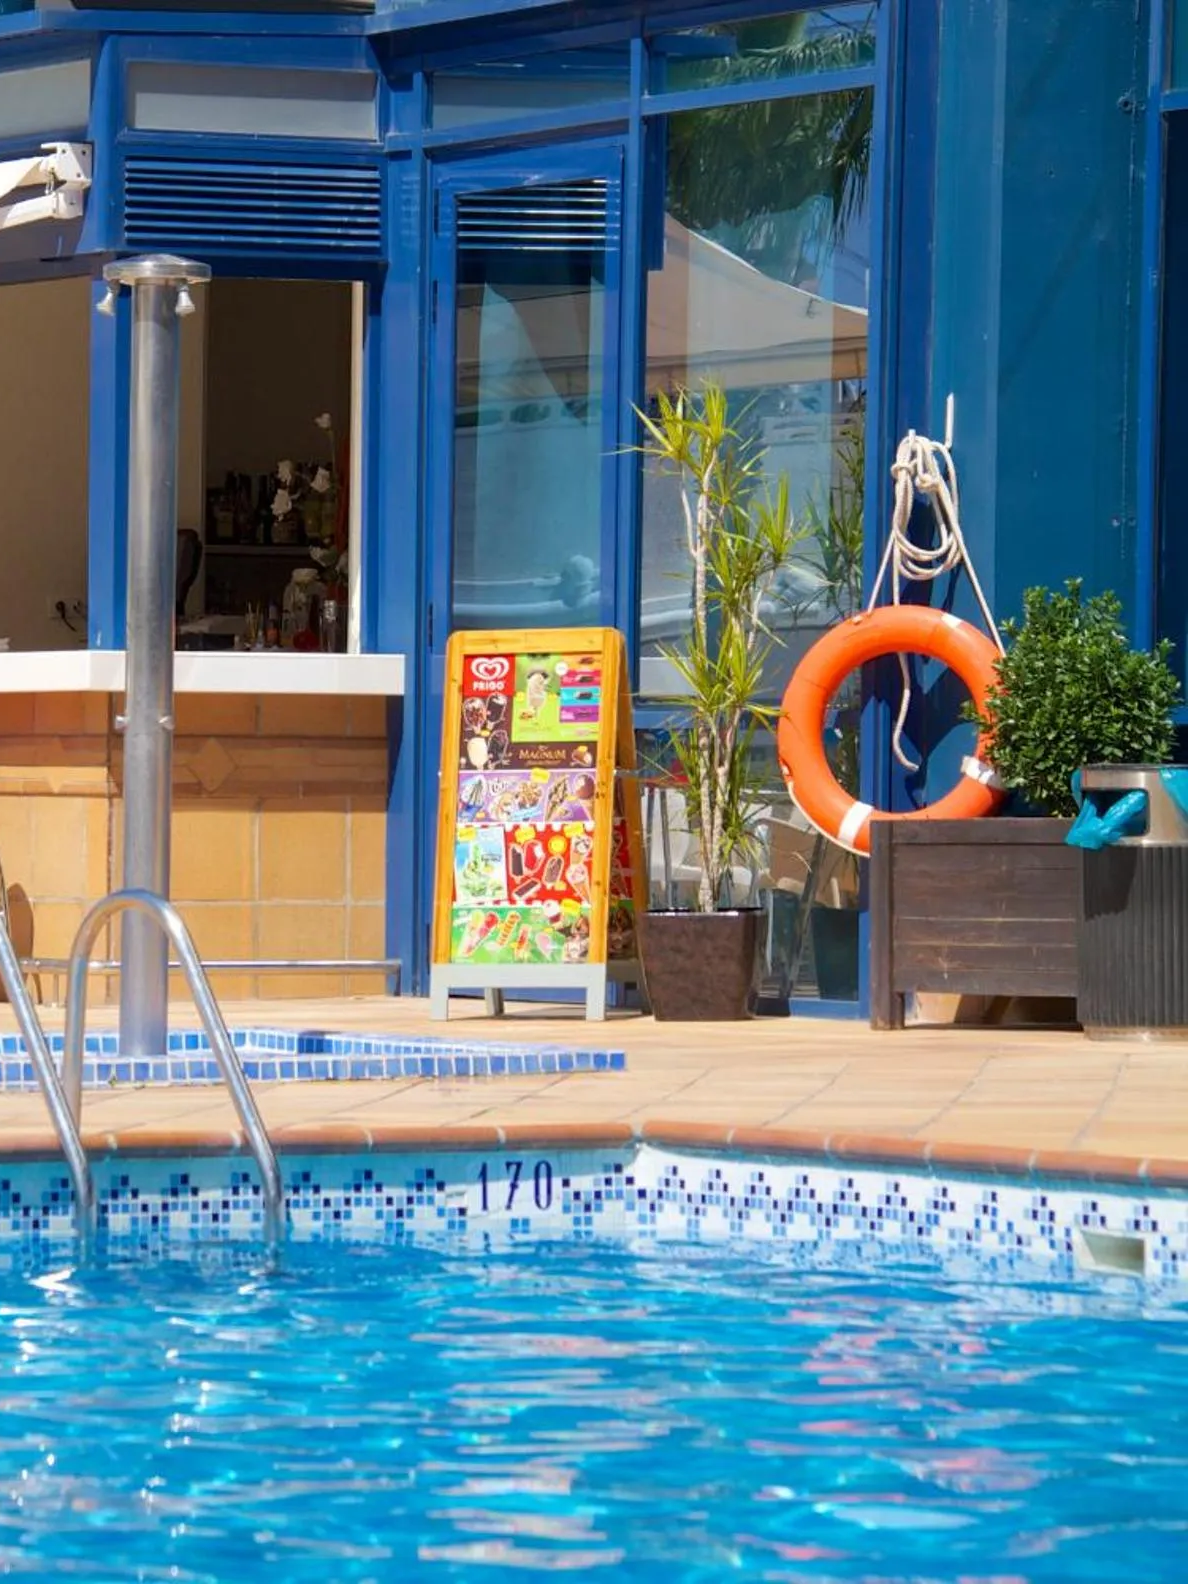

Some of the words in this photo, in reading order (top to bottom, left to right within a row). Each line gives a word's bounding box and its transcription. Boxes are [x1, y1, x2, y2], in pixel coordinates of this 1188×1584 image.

[473, 681, 505, 691] FRIGO
[519, 749, 567, 760] MAGNUM
[477, 1160, 552, 1212] 170
